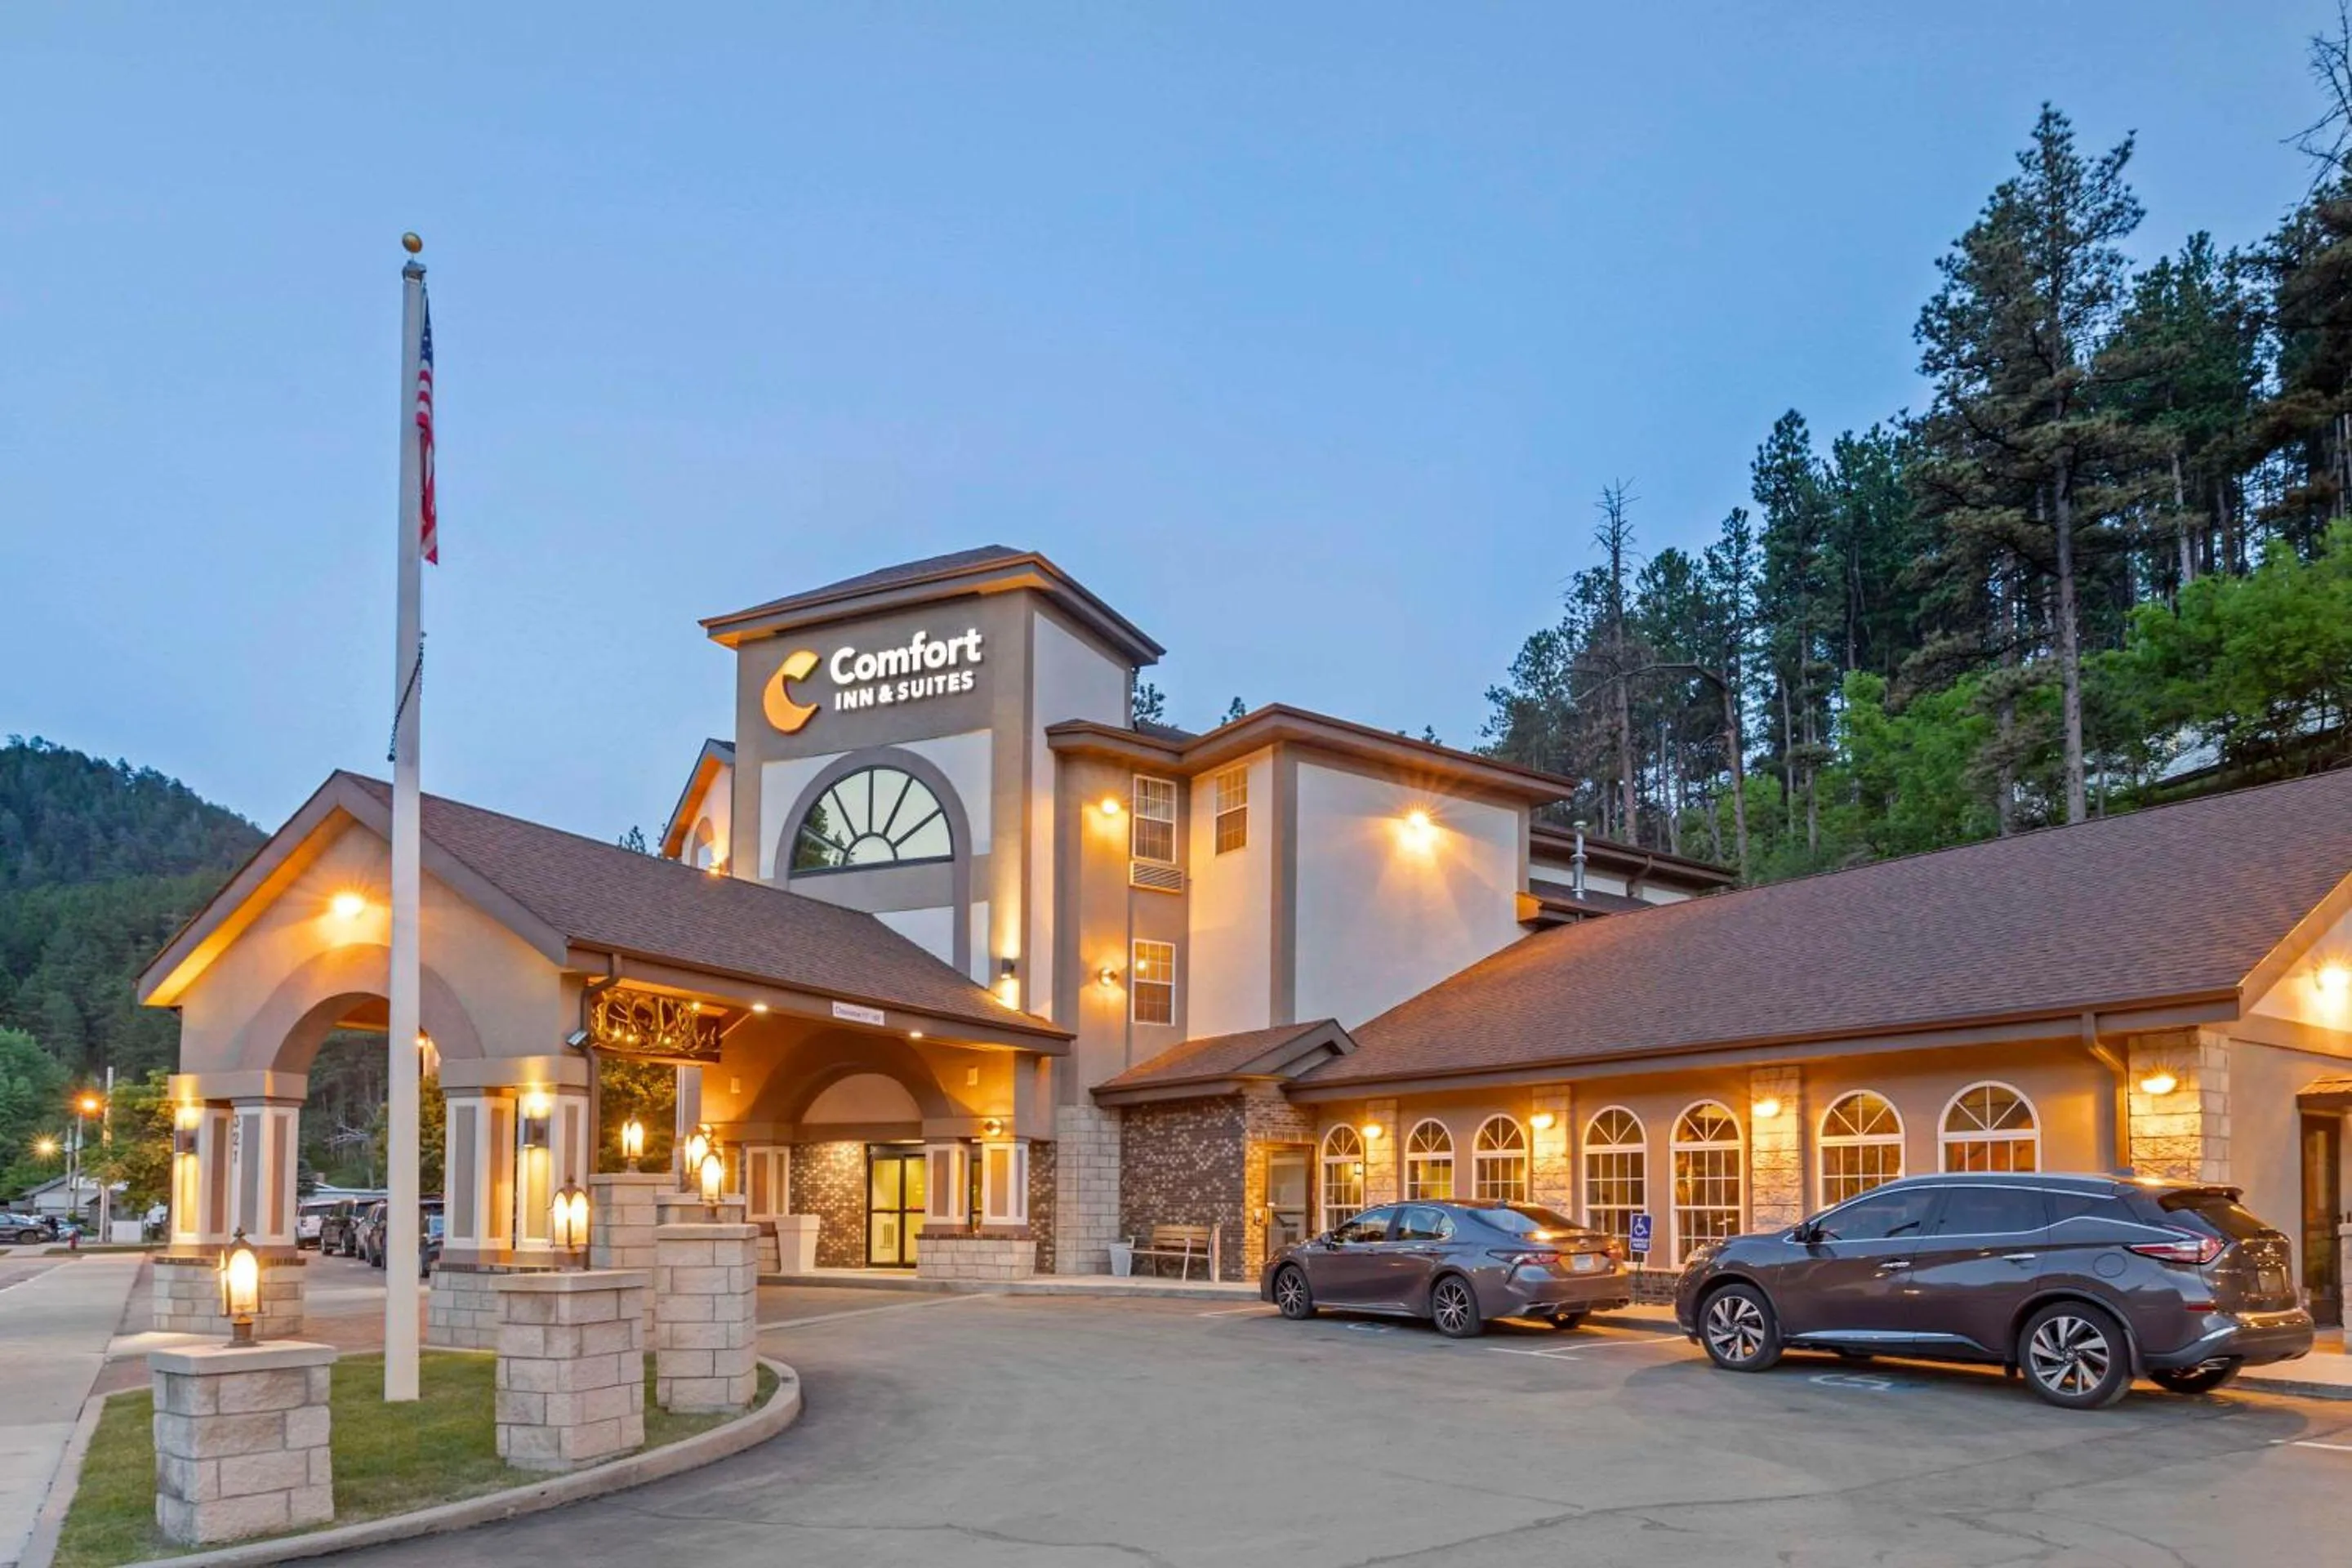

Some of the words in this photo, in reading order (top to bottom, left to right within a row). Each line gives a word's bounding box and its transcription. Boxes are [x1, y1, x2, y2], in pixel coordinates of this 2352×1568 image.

[830, 628, 982, 684] Comfort
[835, 688, 874, 710] INN
[878, 684, 893, 703] &
[898, 670, 974, 701] SUITES
[232, 1114, 241, 1164] 321
